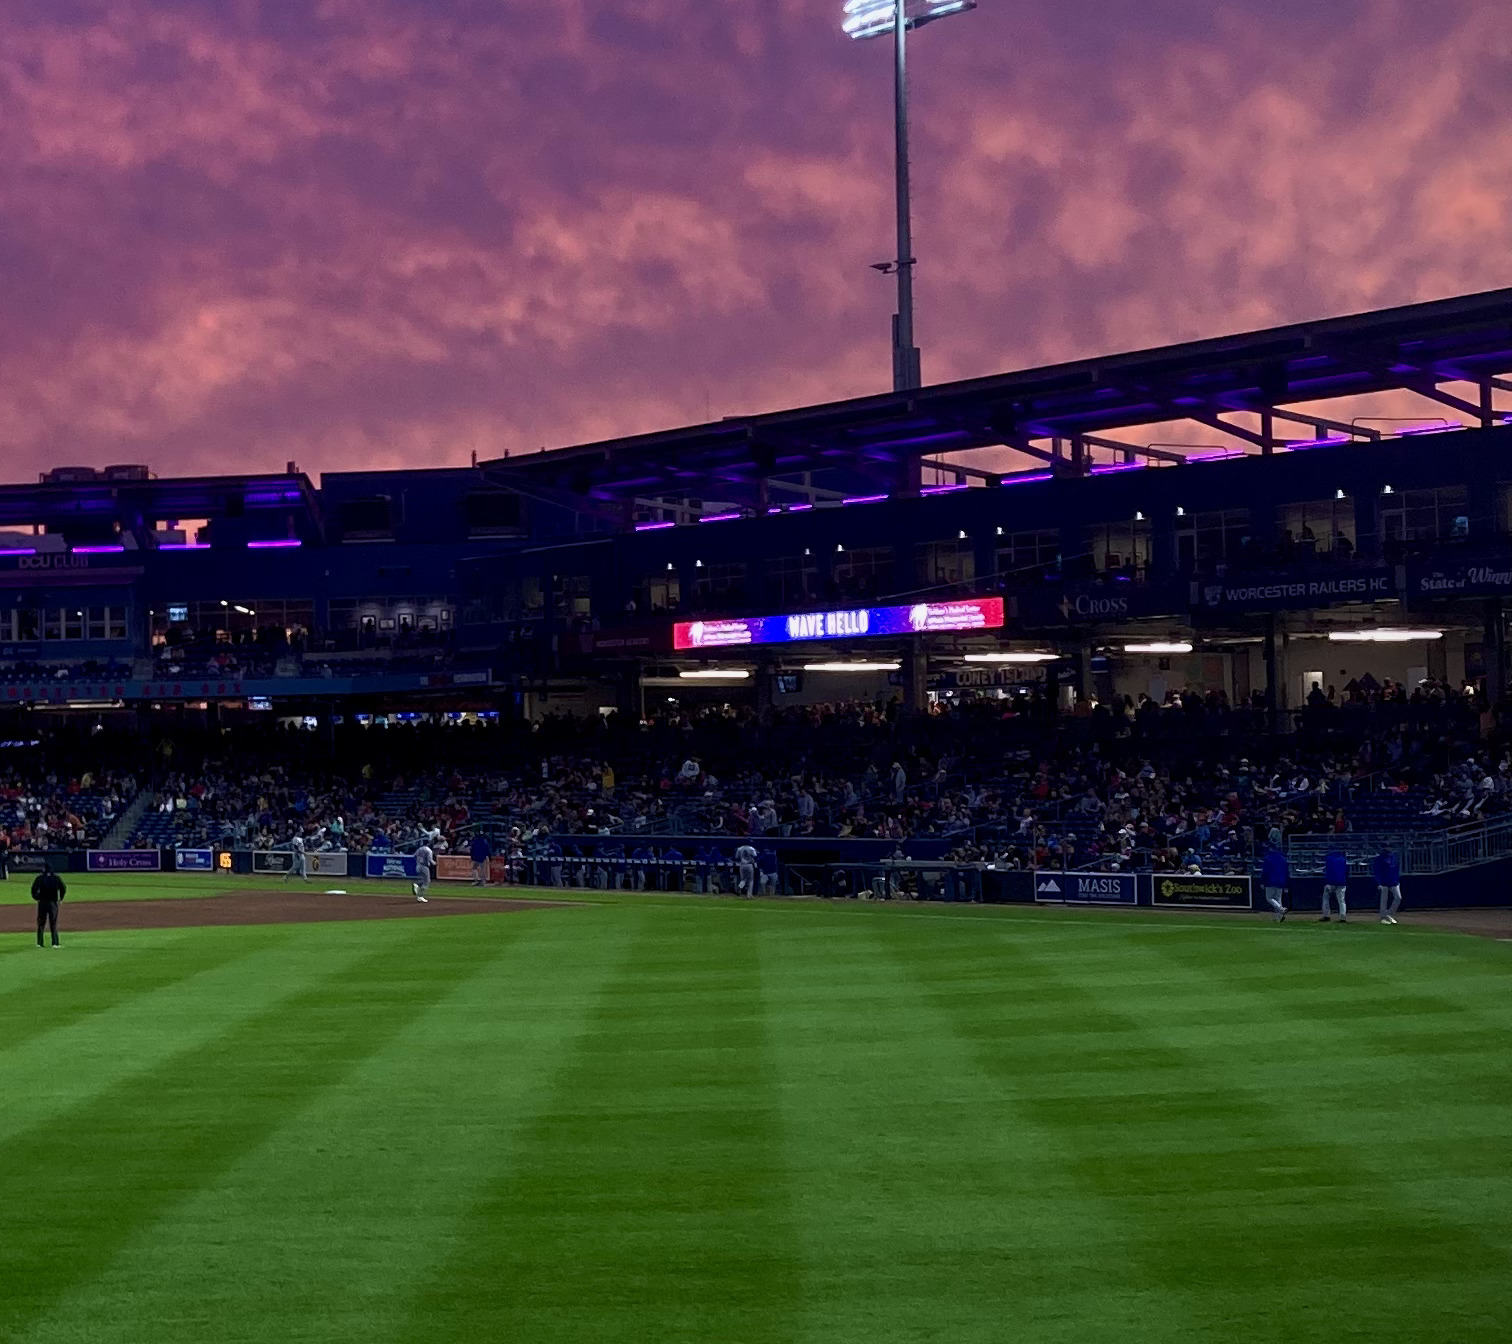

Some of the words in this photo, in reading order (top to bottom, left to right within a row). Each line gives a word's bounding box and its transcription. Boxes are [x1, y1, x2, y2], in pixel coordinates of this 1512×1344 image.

[18, 555, 50, 569] DCU
[54, 554, 88, 568] CLUB
[1225, 584, 1306, 601] WORCESTER
[1309, 579, 1367, 596] RAILERS
[1369, 577, 1388, 591] HC
[788, 613, 824, 638] WAVE
[827, 609, 869, 635] HELLO
[108, 857, 128, 868] Holy
[129, 857, 152, 867] Cross
[1078, 878, 1121, 894] MASIS
[1225, 884, 1243, 895] Zoo
